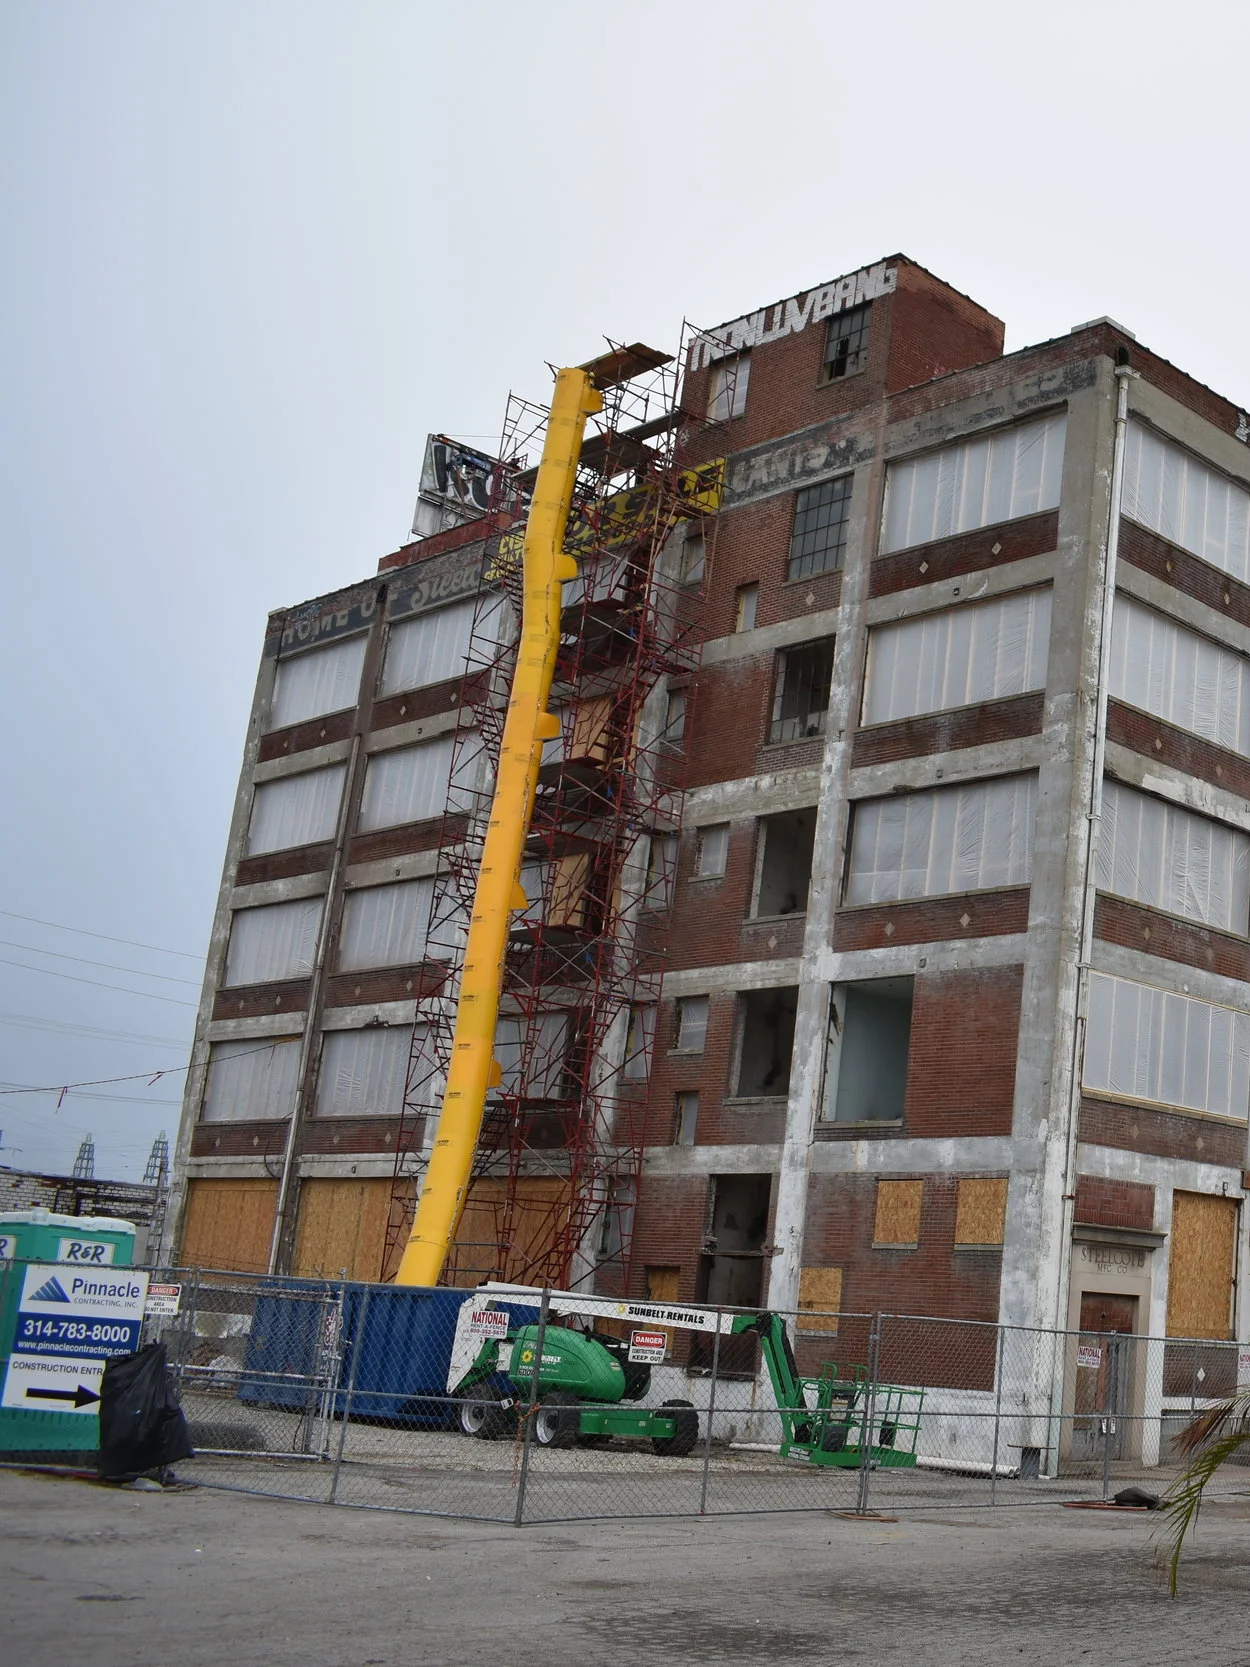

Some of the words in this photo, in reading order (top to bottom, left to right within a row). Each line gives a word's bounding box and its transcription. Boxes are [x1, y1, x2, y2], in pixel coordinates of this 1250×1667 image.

[66, 1242, 105, 1263] R&R
[1081, 1247, 1145, 1268] STEELCOTE
[72, 1278, 140, 1299] Pinnacle
[151, 1286, 174, 1295] DANGER
[471, 1311, 507, 1326] NATIONAL
[628, 1306, 665, 1319] SUNBELT
[666, 1313, 705, 1325] RENTALS
[24, 1319, 131, 1343] 314-783-8000
[18, 1340, 131, 1357] www.pinnaclecontracting.com
[635, 1336, 663, 1345] DANGER
[12, 1360, 78, 1374] CONSTRUCTION
[81, 1366, 104, 1376] ENTR
